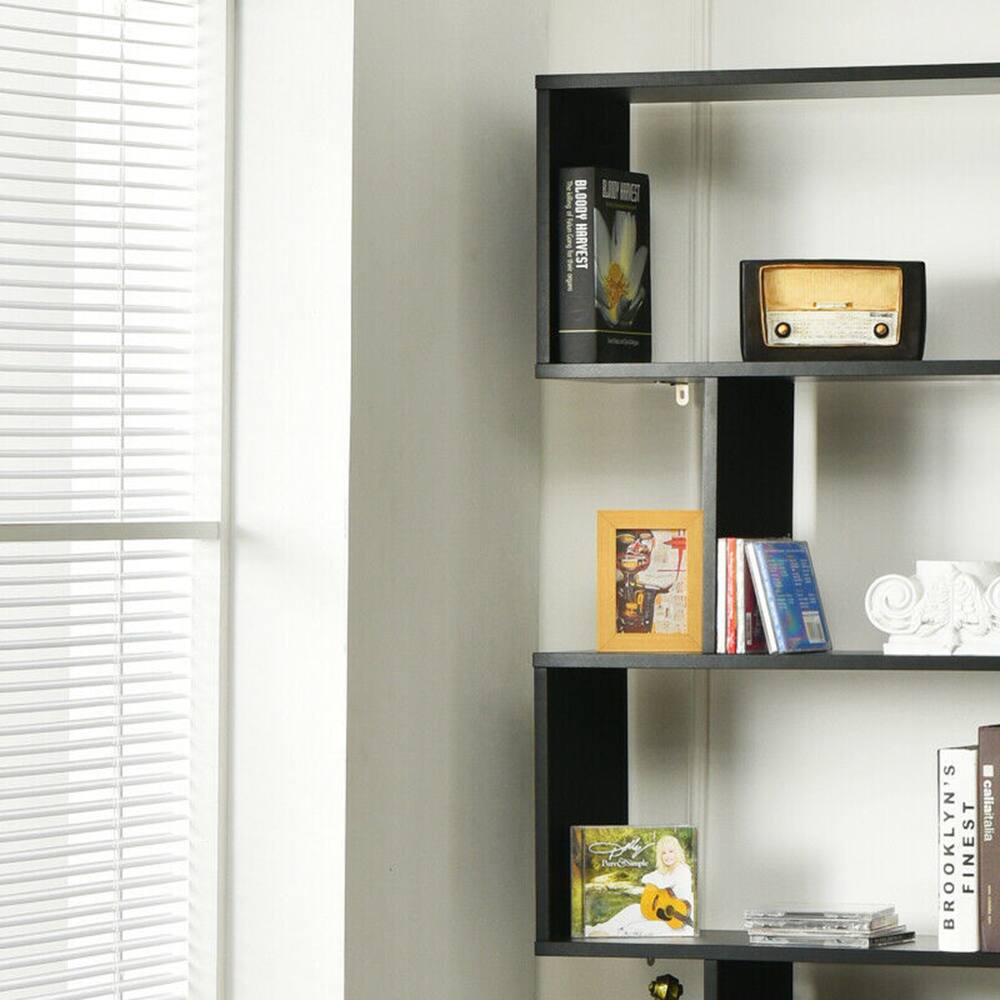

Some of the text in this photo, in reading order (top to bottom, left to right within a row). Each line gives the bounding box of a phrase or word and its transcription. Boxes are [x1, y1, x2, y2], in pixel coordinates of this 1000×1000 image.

[575, 179, 589, 269] BLOODY HARVEST
[943, 764, 955, 930] BROOKLYN'S
[962, 802, 975, 894] FINEST
[983, 779, 994, 842] caliaitalia
